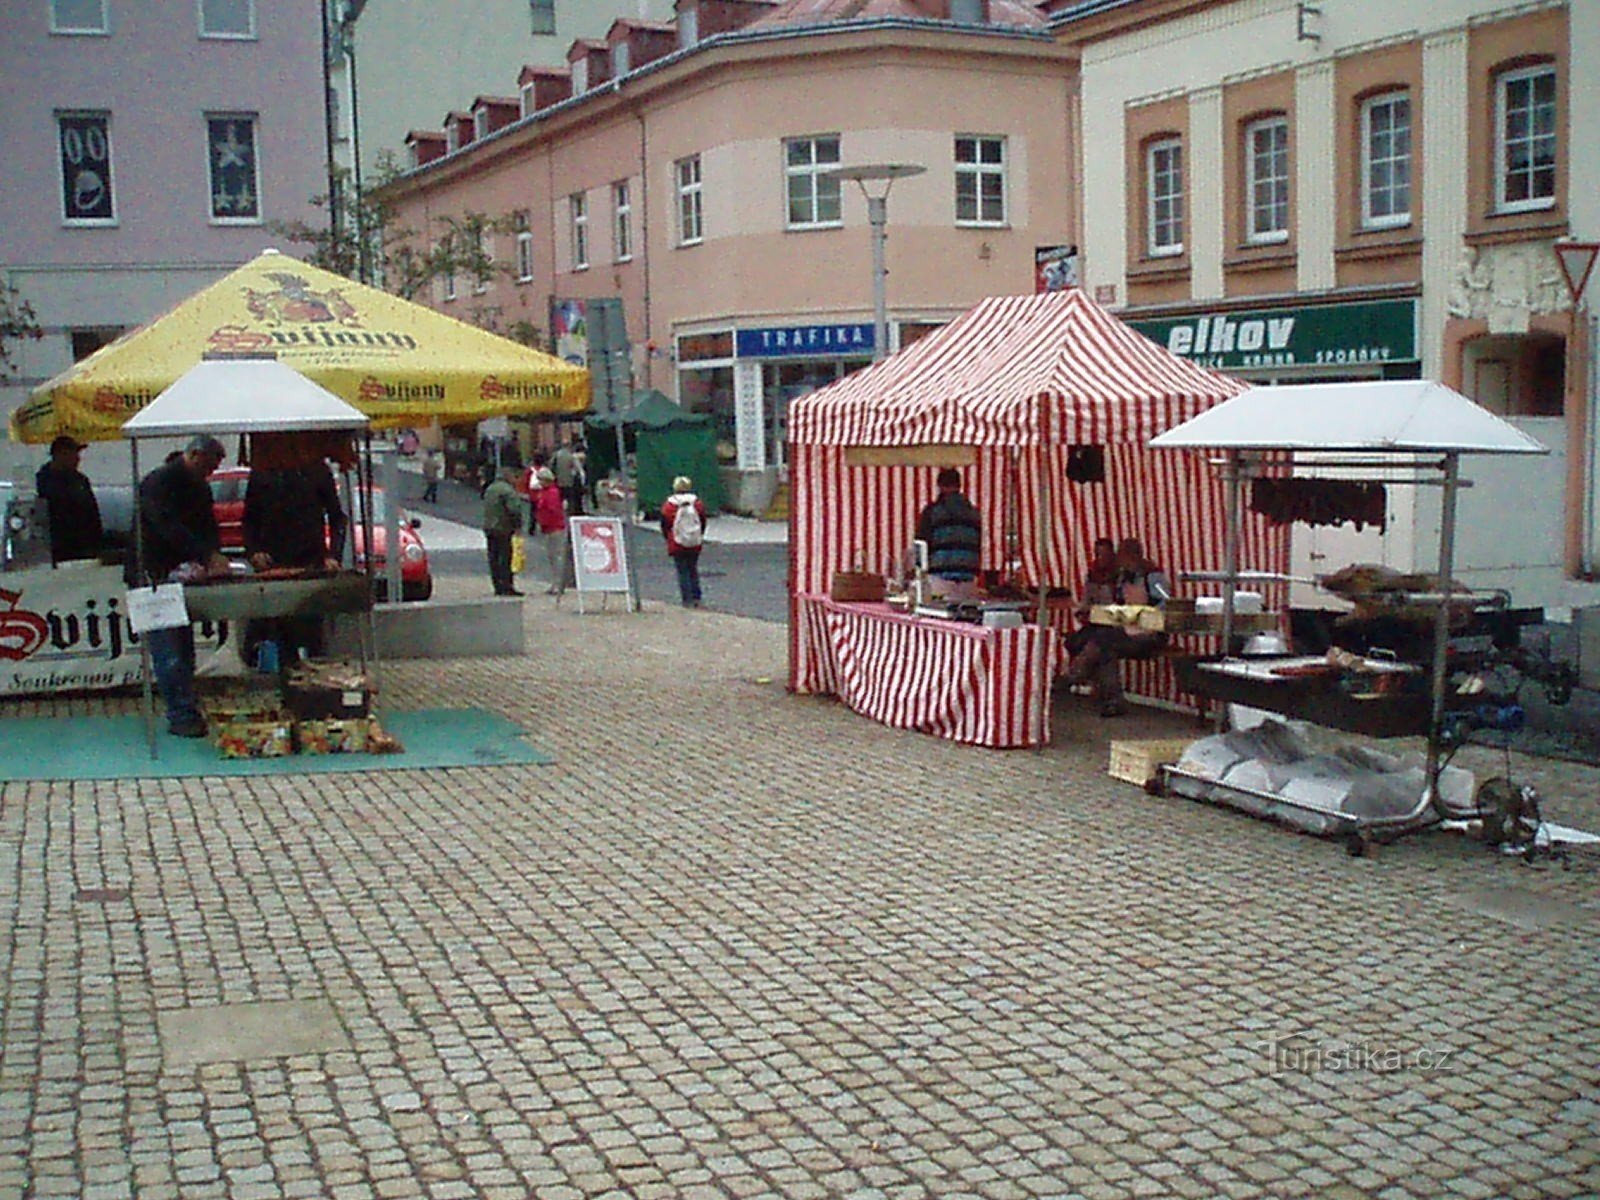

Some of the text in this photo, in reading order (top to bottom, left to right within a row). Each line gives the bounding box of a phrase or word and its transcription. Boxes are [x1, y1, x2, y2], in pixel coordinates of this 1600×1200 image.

[762, 326, 863, 348] TRAFIKA
[1168, 317, 1295, 354] elkov
[91, 386, 154, 414] Svij
[359, 375, 446, 402] Svijany
[0, 587, 229, 661] Svijy
